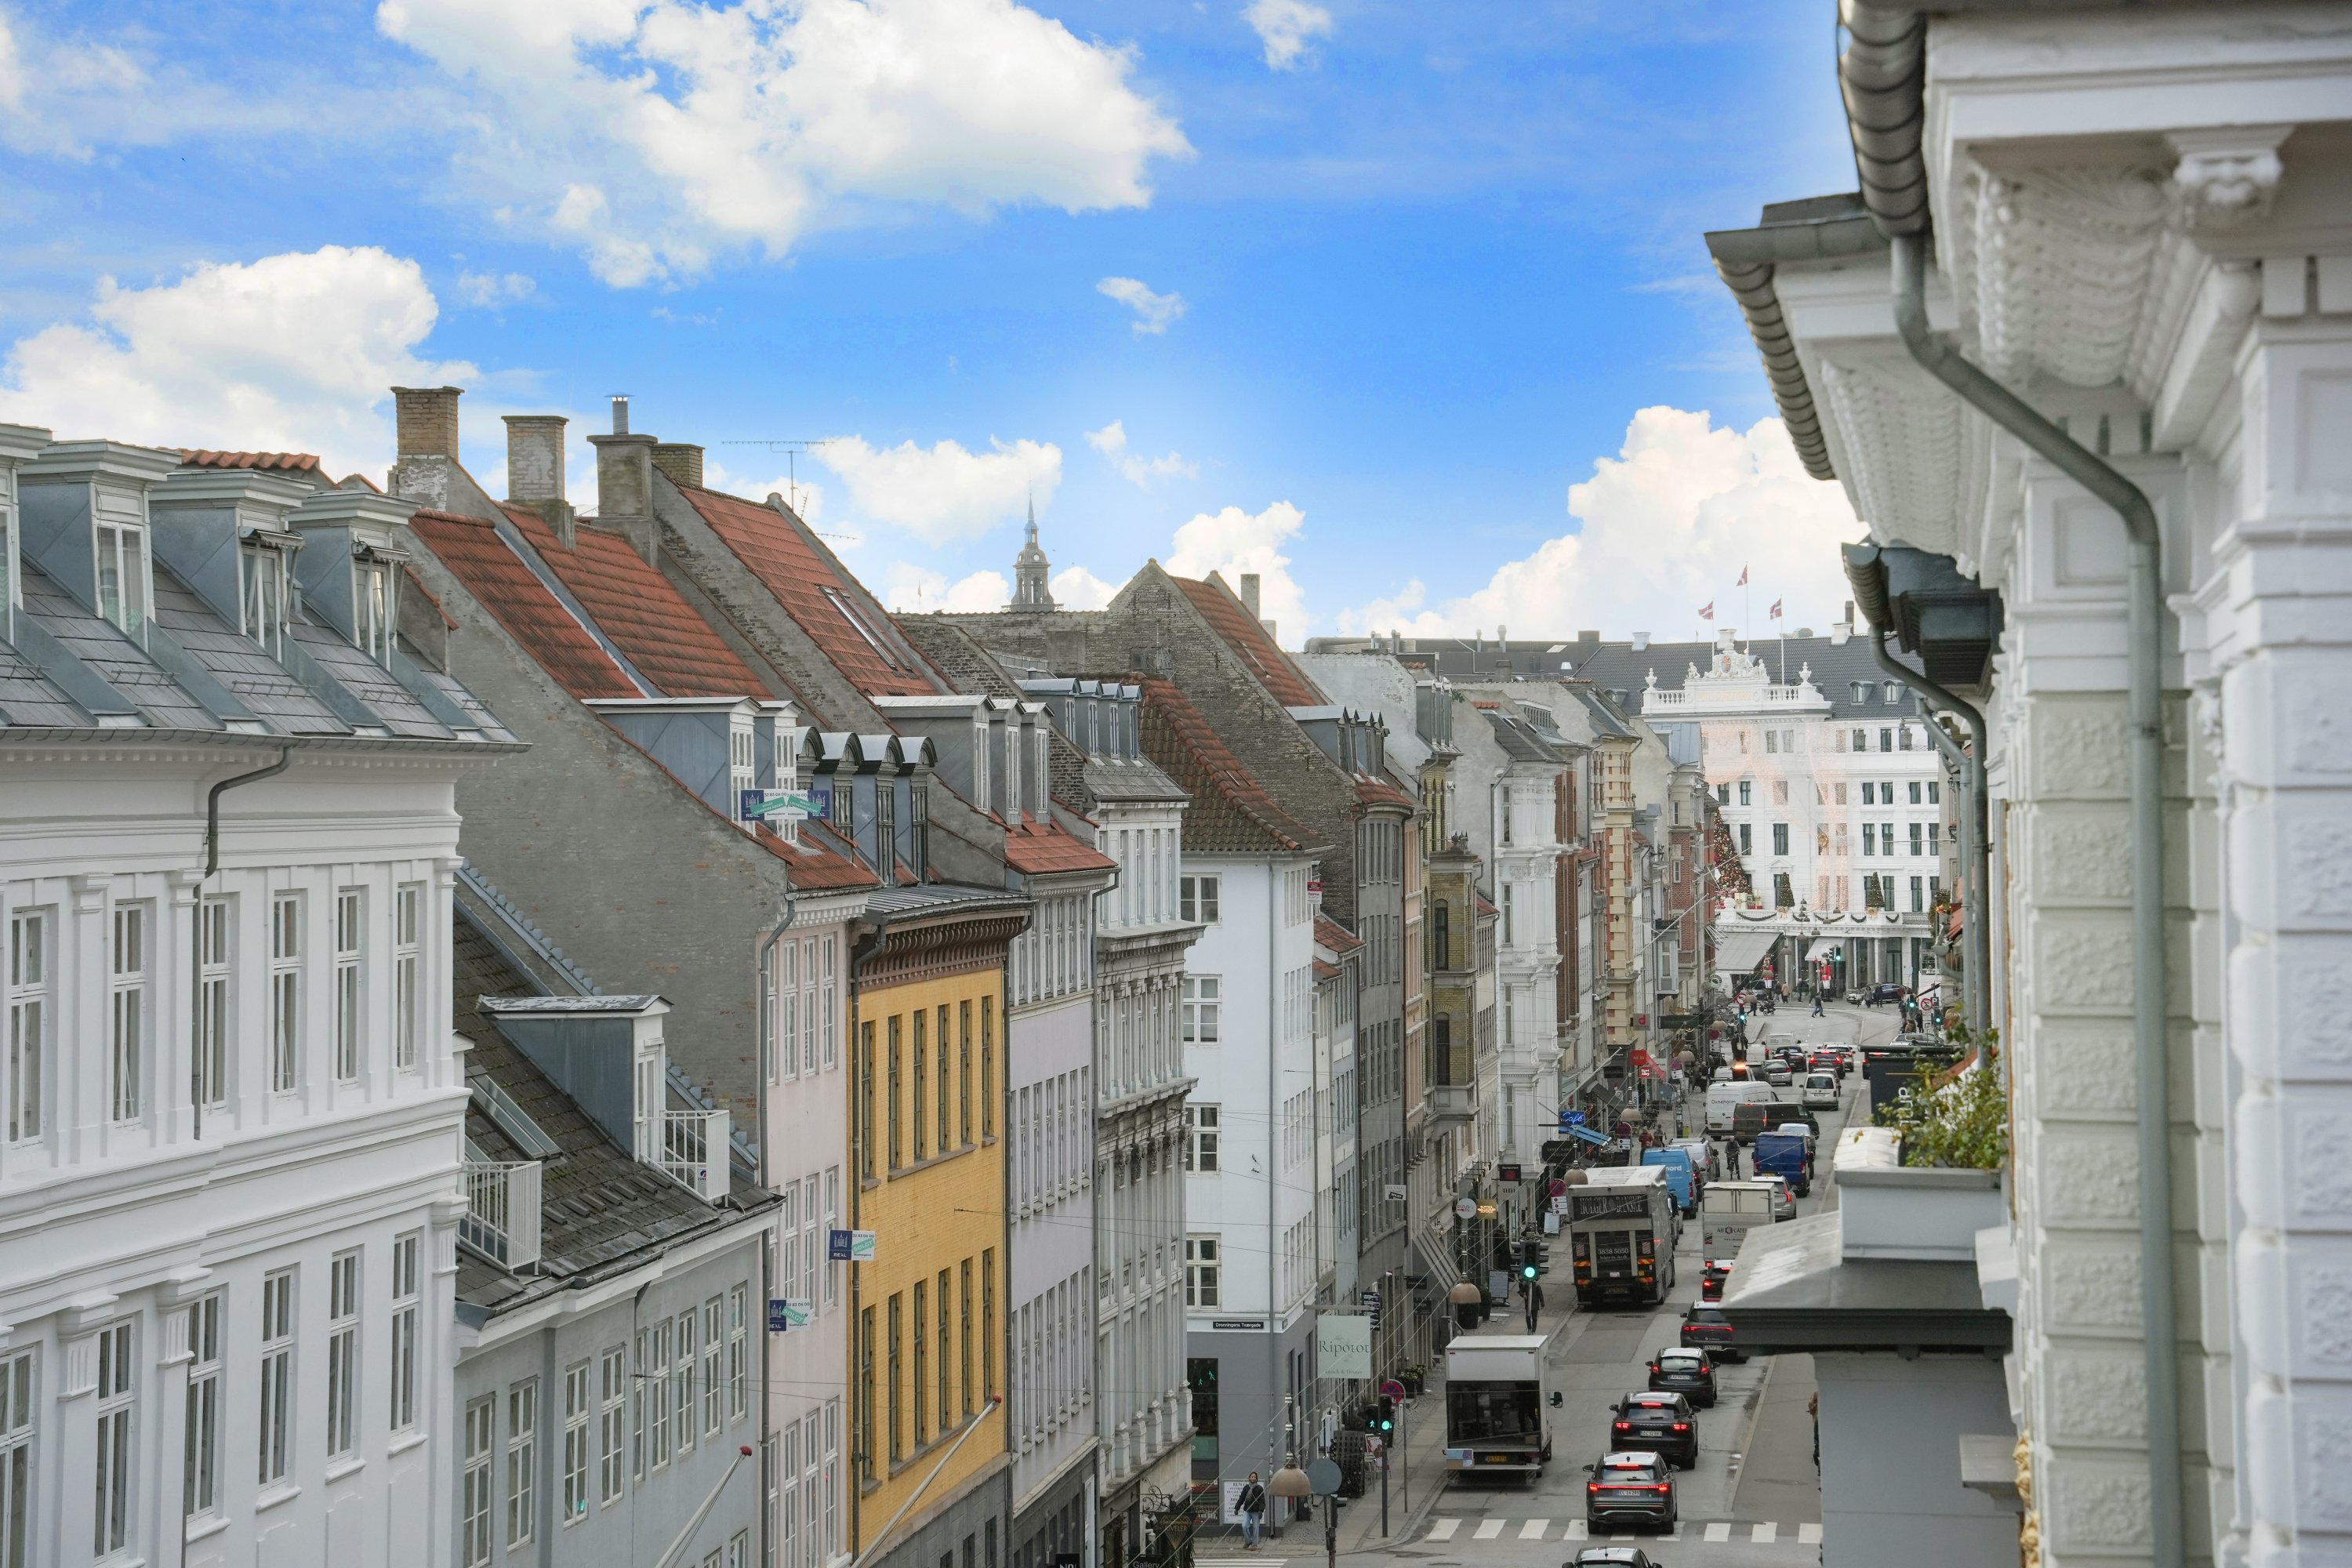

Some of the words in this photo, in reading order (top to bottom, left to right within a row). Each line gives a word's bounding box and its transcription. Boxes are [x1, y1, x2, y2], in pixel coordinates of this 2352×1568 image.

[1562, 1112, 1584, 1124] Café
[1579, 1196, 1608, 1214] HOLGER
[853, 1240, 873, 1251] SOLGT
[783, 1308, 804, 1323] SOLGT
[1319, 1340, 1370, 1357] Ripotot
